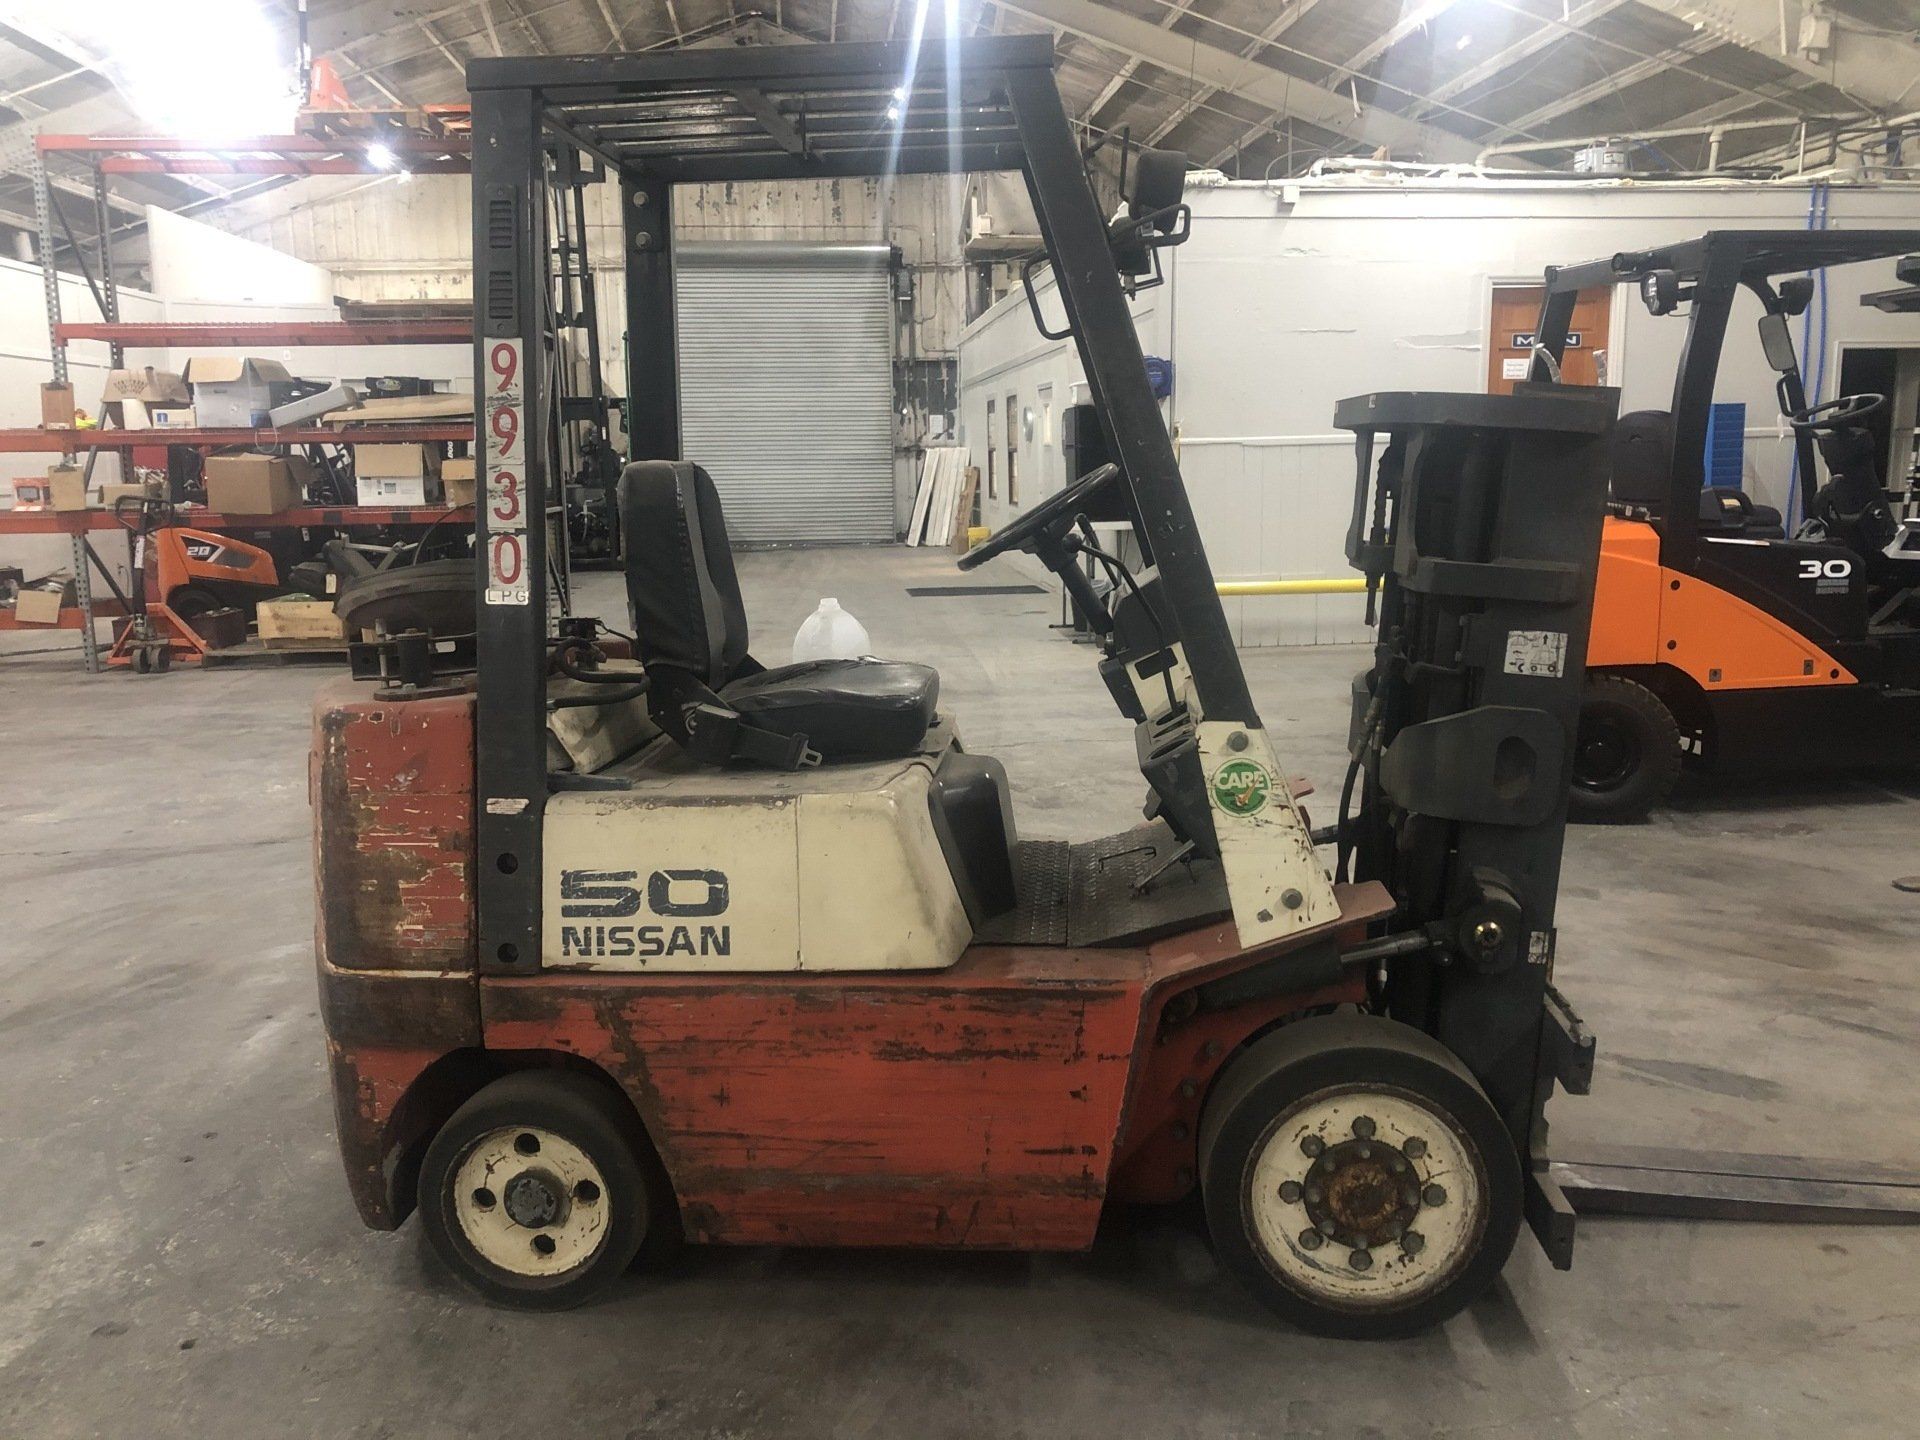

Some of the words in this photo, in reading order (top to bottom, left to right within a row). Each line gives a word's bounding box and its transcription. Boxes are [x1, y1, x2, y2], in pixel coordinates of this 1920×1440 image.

[1798, 559, 1852, 579] 30
[1215, 770, 1265, 790] CARE
[560, 869, 730, 918] 50
[561, 925, 731, 956] NISSAN
